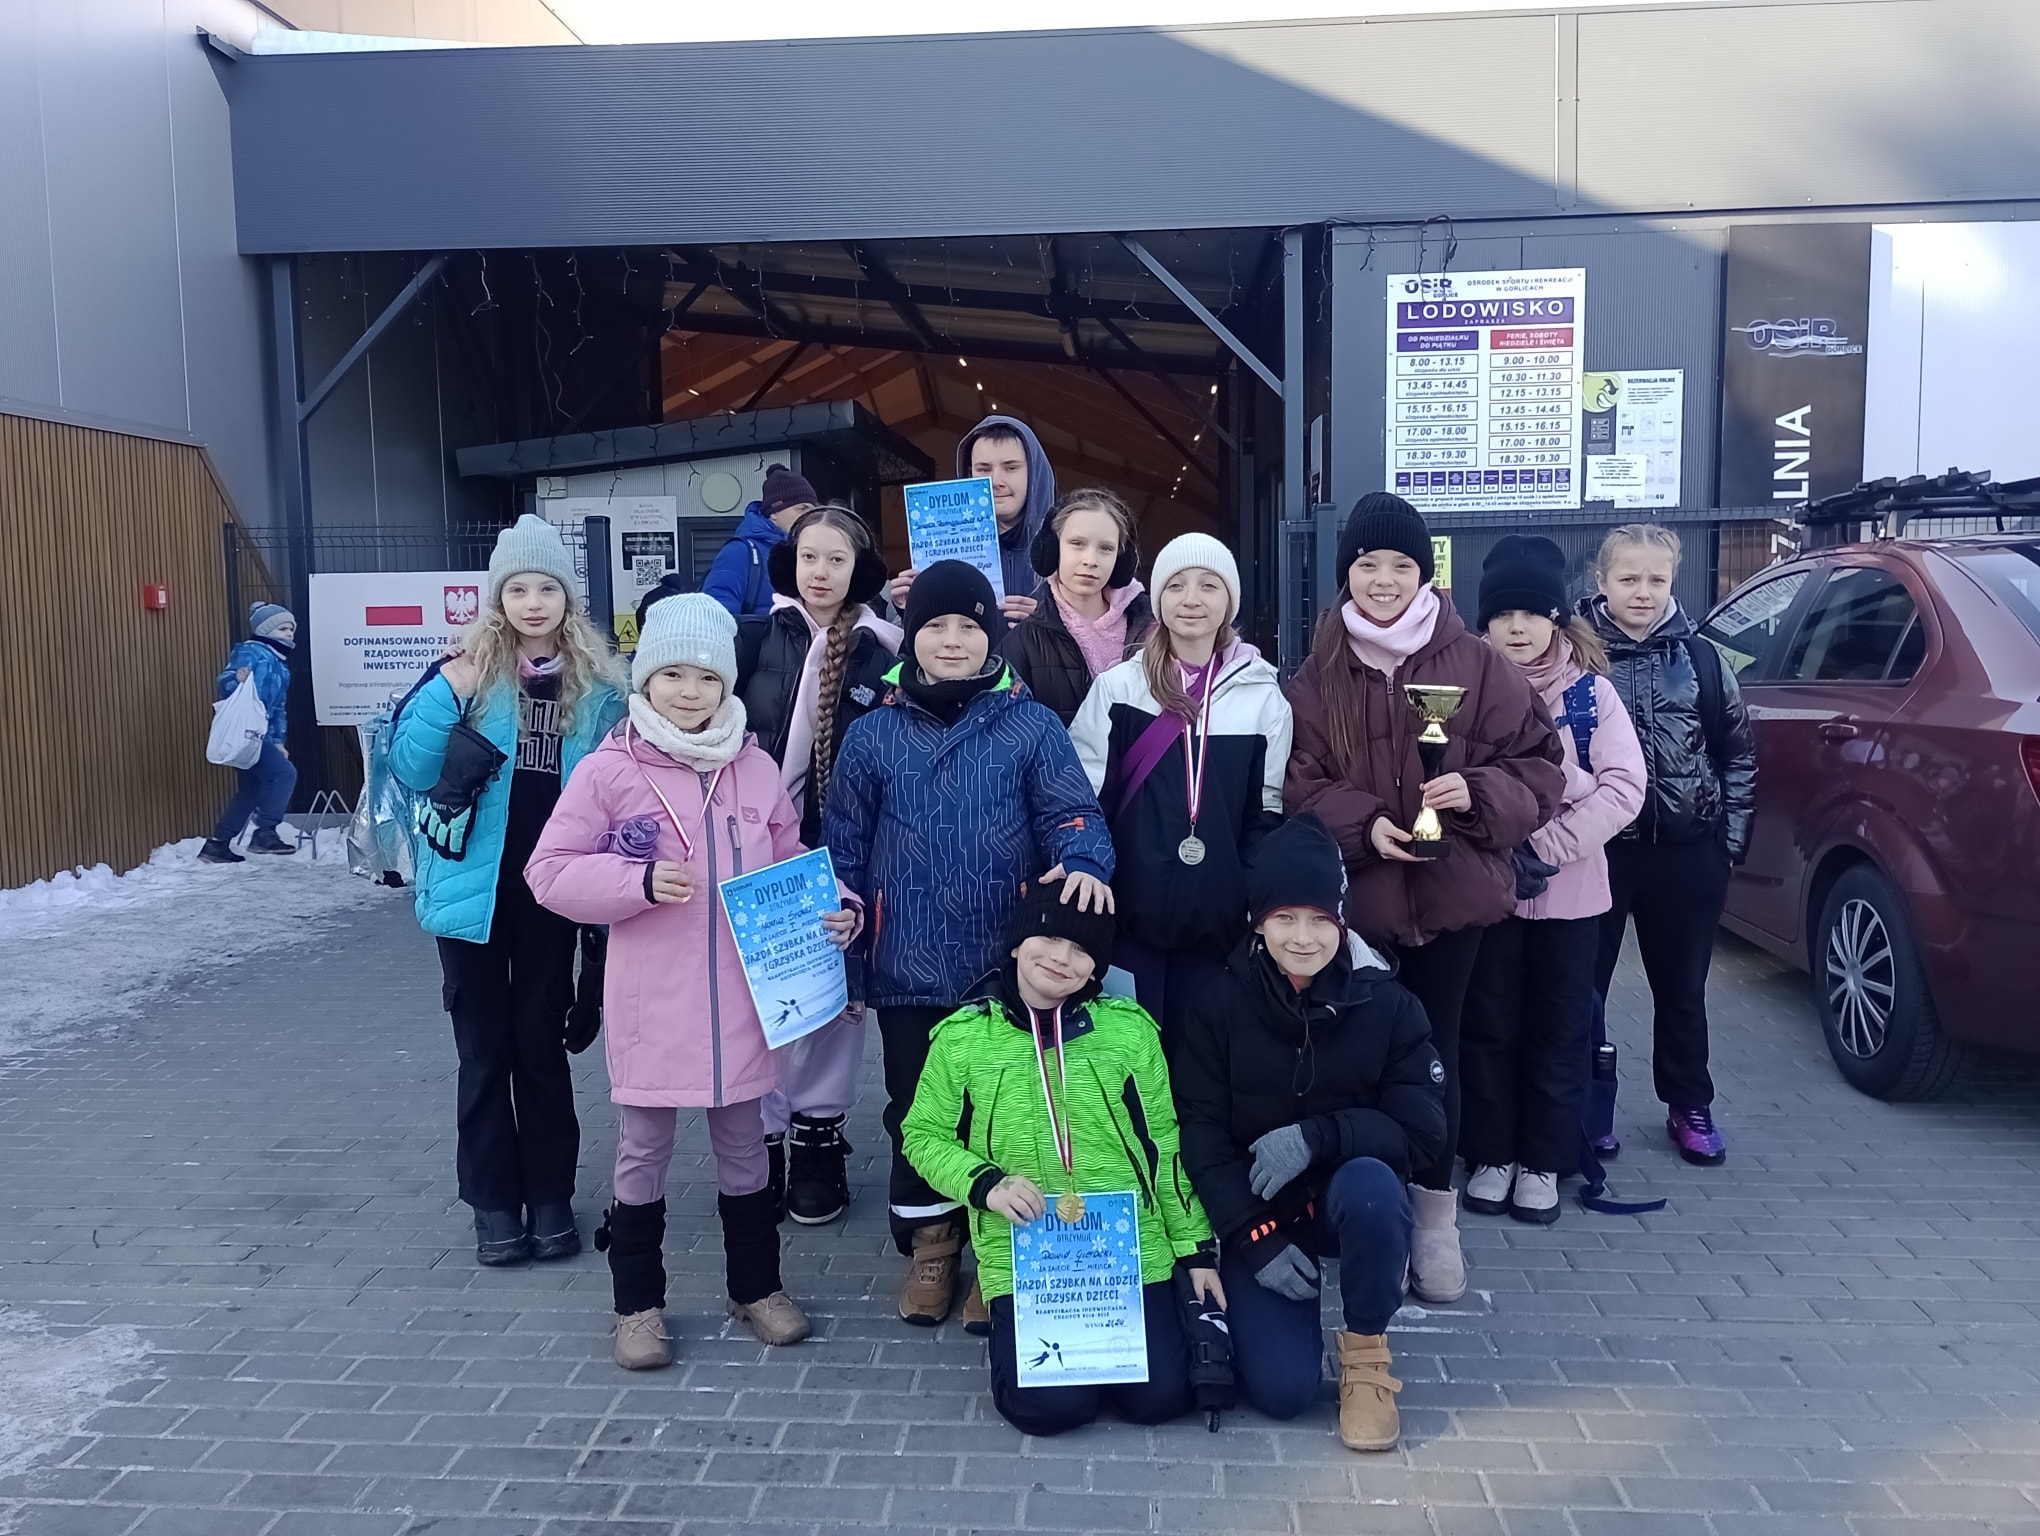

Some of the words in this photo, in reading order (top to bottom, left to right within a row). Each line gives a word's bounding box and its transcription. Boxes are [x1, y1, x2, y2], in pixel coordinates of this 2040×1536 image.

[1407, 300, 1564, 320] LODOWISKO
[1499, 339, 1534, 347] NIEDZIELE
[1410, 358, 1430, 367] 8.00
[1440, 357, 1465, 366] 13.15
[1503, 356, 1524, 365] 9.00
[1534, 355, 1560, 364] 10.00
[1501, 373, 1527, 382] 10.30
[1537, 372, 1562, 381] 11.30
[1407, 381, 1432, 390] 13.45
[1442, 380, 1467, 389] 14.45
[1501, 388, 1526, 397] 12.15
[1536, 387, 1561, 396] 13.15
[1407, 404, 1432, 413] 15.15
[1442, 403, 1467, 412] 16.15
[1500, 405, 1525, 414] 13.45
[1536, 404, 1561, 413] 14.45
[1407, 427, 1432, 436] 17.00
[1442, 426, 1467, 435] 18.00
[1500, 422, 1525, 431] 15.15
[1535, 421, 1561, 430] 16.15
[1500, 438, 1525, 447] 17.00
[1535, 437, 1560, 446] 18.00
[1407, 450, 1432, 460] 18.30
[1441, 450, 1467, 459] 19.30
[1500, 454, 1525, 464] 18.30
[1535, 453, 1560, 462] 19.30
[929, 491, 970, 509] DYPLOM
[912, 540, 933, 549] JAZDA
[934, 537, 960, 547] SZYBKA
[925, 547, 959, 557] IGRZYSKA
[961, 544, 984, 553] DZIECI
[344, 637, 435, 646] DOFINANSOWANO
[437, 636, 449, 645] ZE
[364, 649, 429, 660] RZĄDOWEGO
[363, 661, 424, 670] INWESTYCJI
[338, 681, 368, 689] Poprawa
[754, 873, 807, 906] DYPLOM
[745, 948, 773, 965] JAZDA
[773, 935, 806, 955] SZYBKA
[805, 930, 819, 941] NA
[763, 949, 807, 972] IGRZYSKA
[806, 937, 833, 954] DZIEC
[1016, 1279, 1047, 1291] JAZDA
[1050, 1277, 1087, 1289] SZYBKA
[1089, 1277, 1102, 1287] NA
[1104, 1274, 1139, 1287] LODZIE
[1035, 1292, 1084, 1304] IGRZYSKA
[1086, 1289, 1120, 1301] DZIECI
